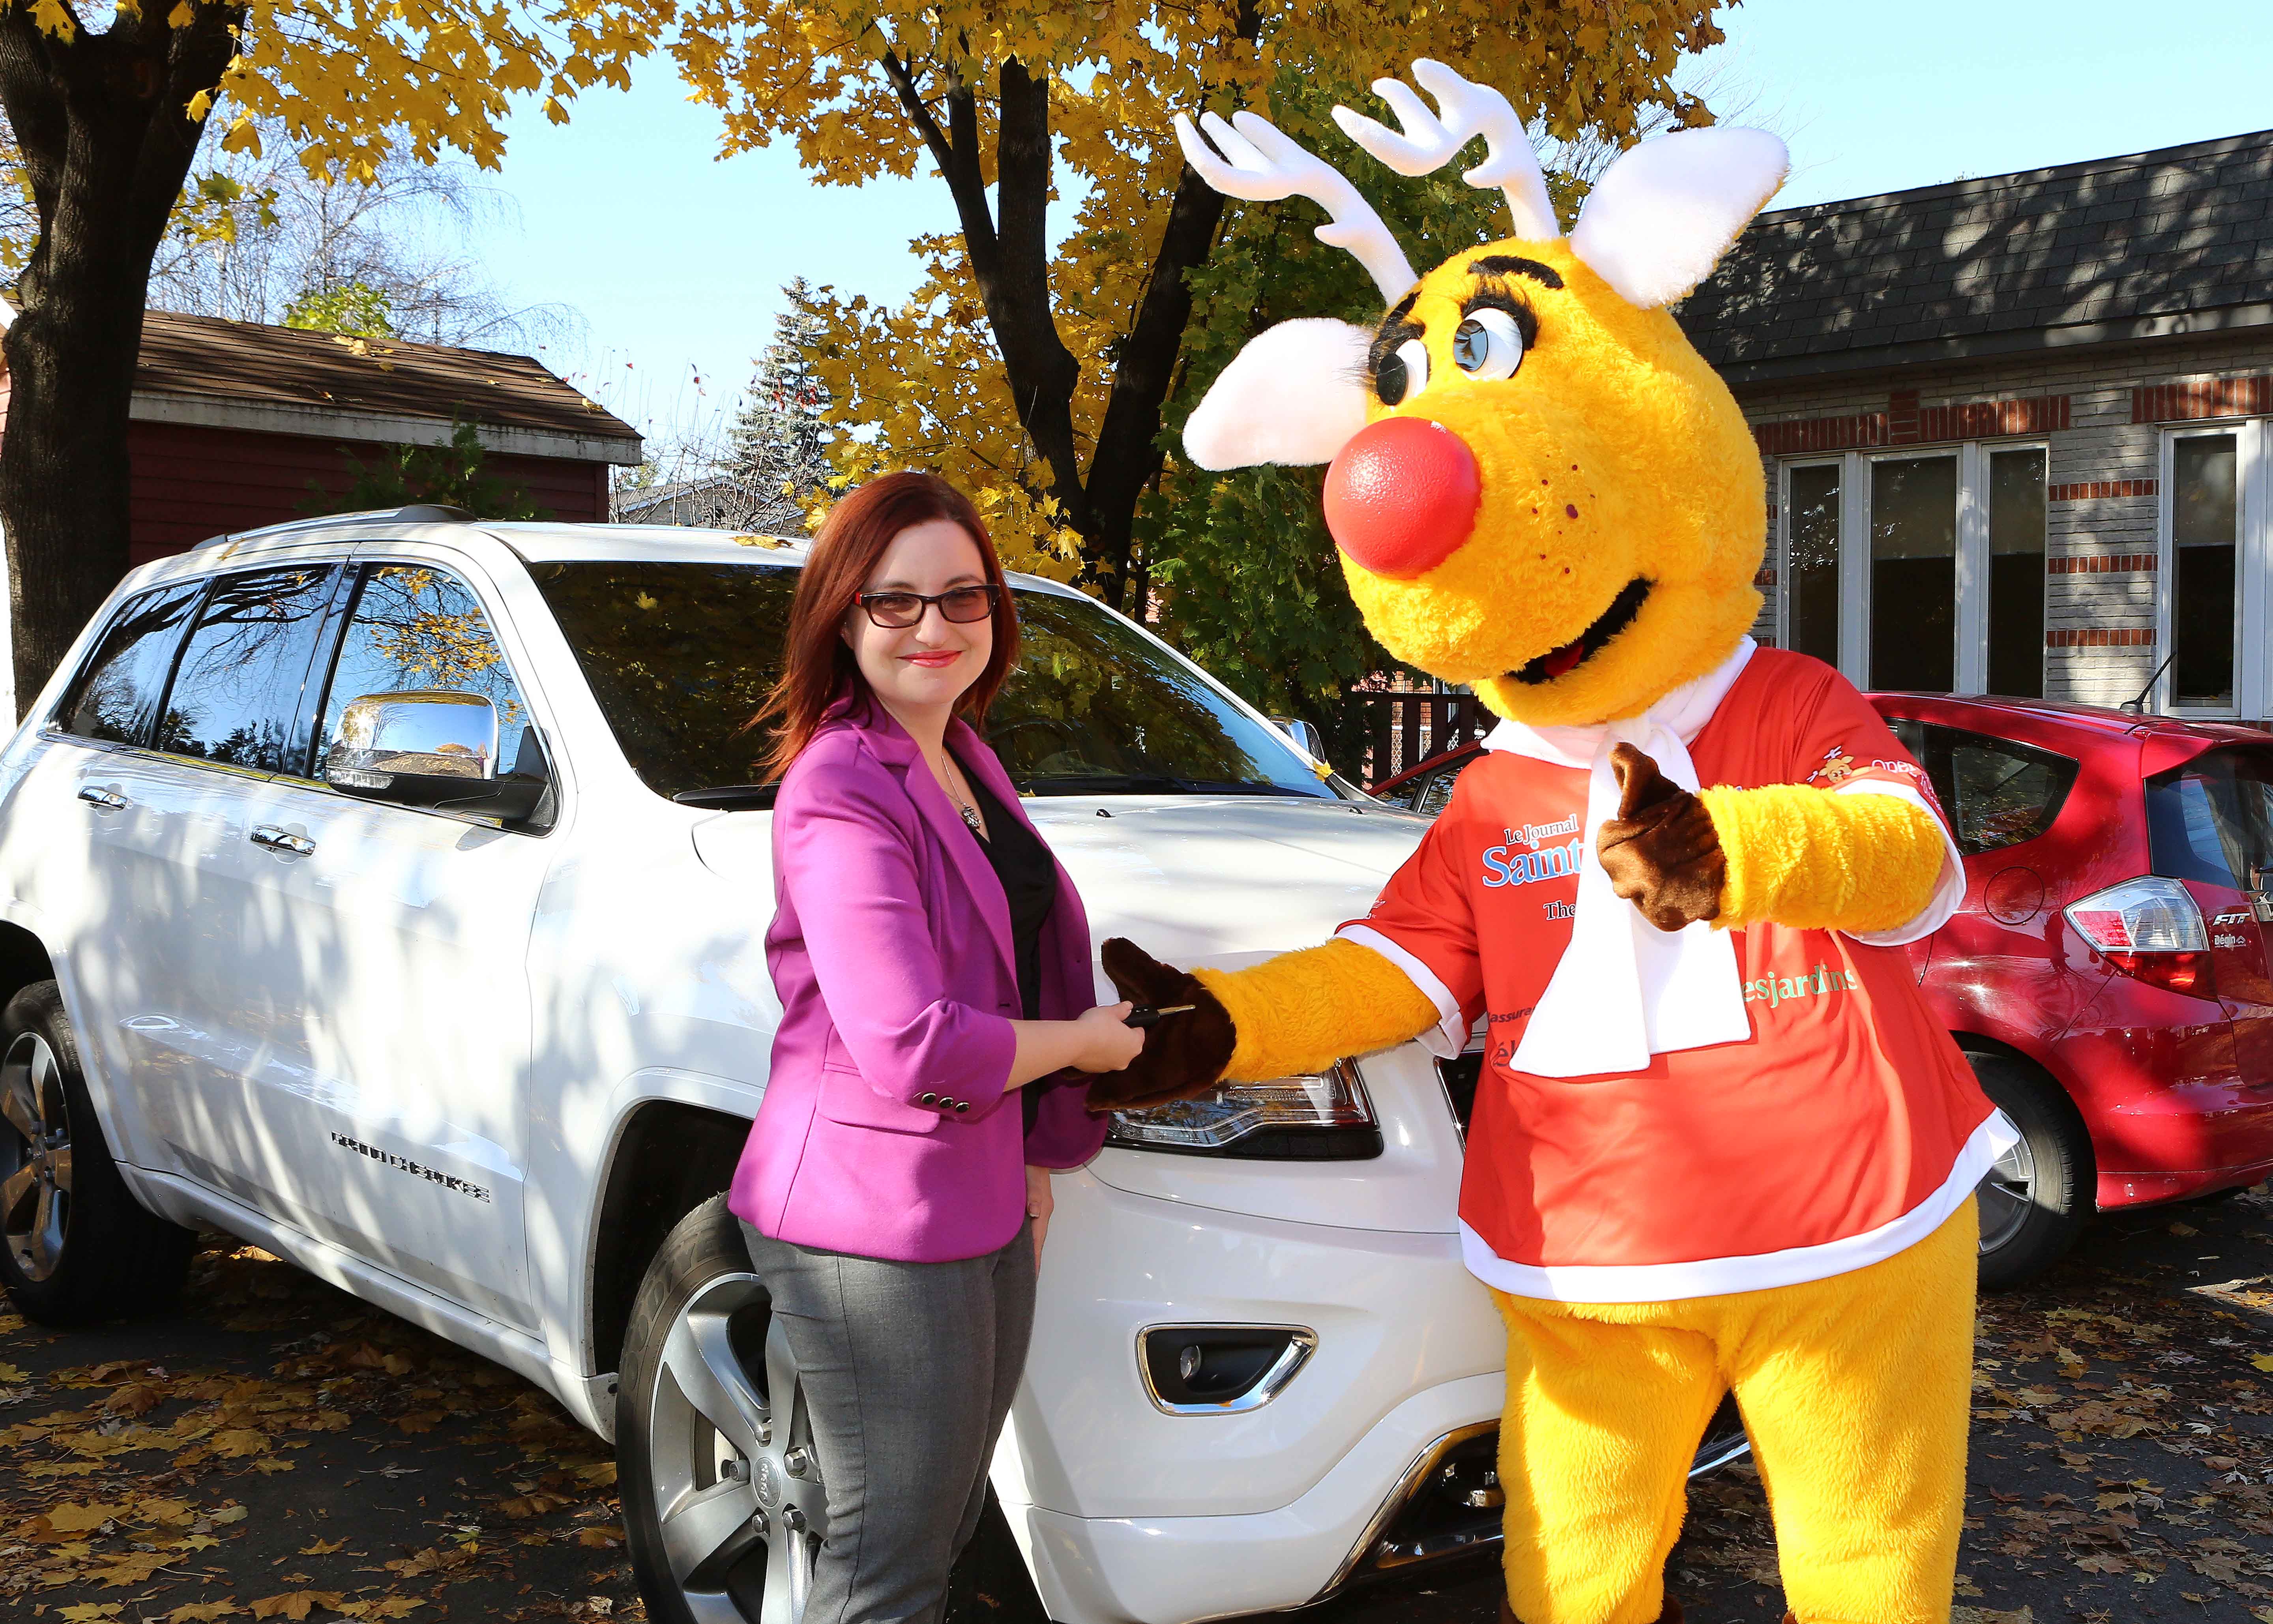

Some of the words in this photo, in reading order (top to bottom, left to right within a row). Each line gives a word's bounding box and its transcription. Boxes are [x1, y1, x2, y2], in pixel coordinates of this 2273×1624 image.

[1504, 828, 1524, 845] Le
[1523, 813, 1579, 845] Journal
[1482, 837, 1584, 888] Saint
[1543, 900, 1576, 920] The
[2212, 912, 2251, 926] FIT
[1741, 963, 1857, 1008] esjardins
